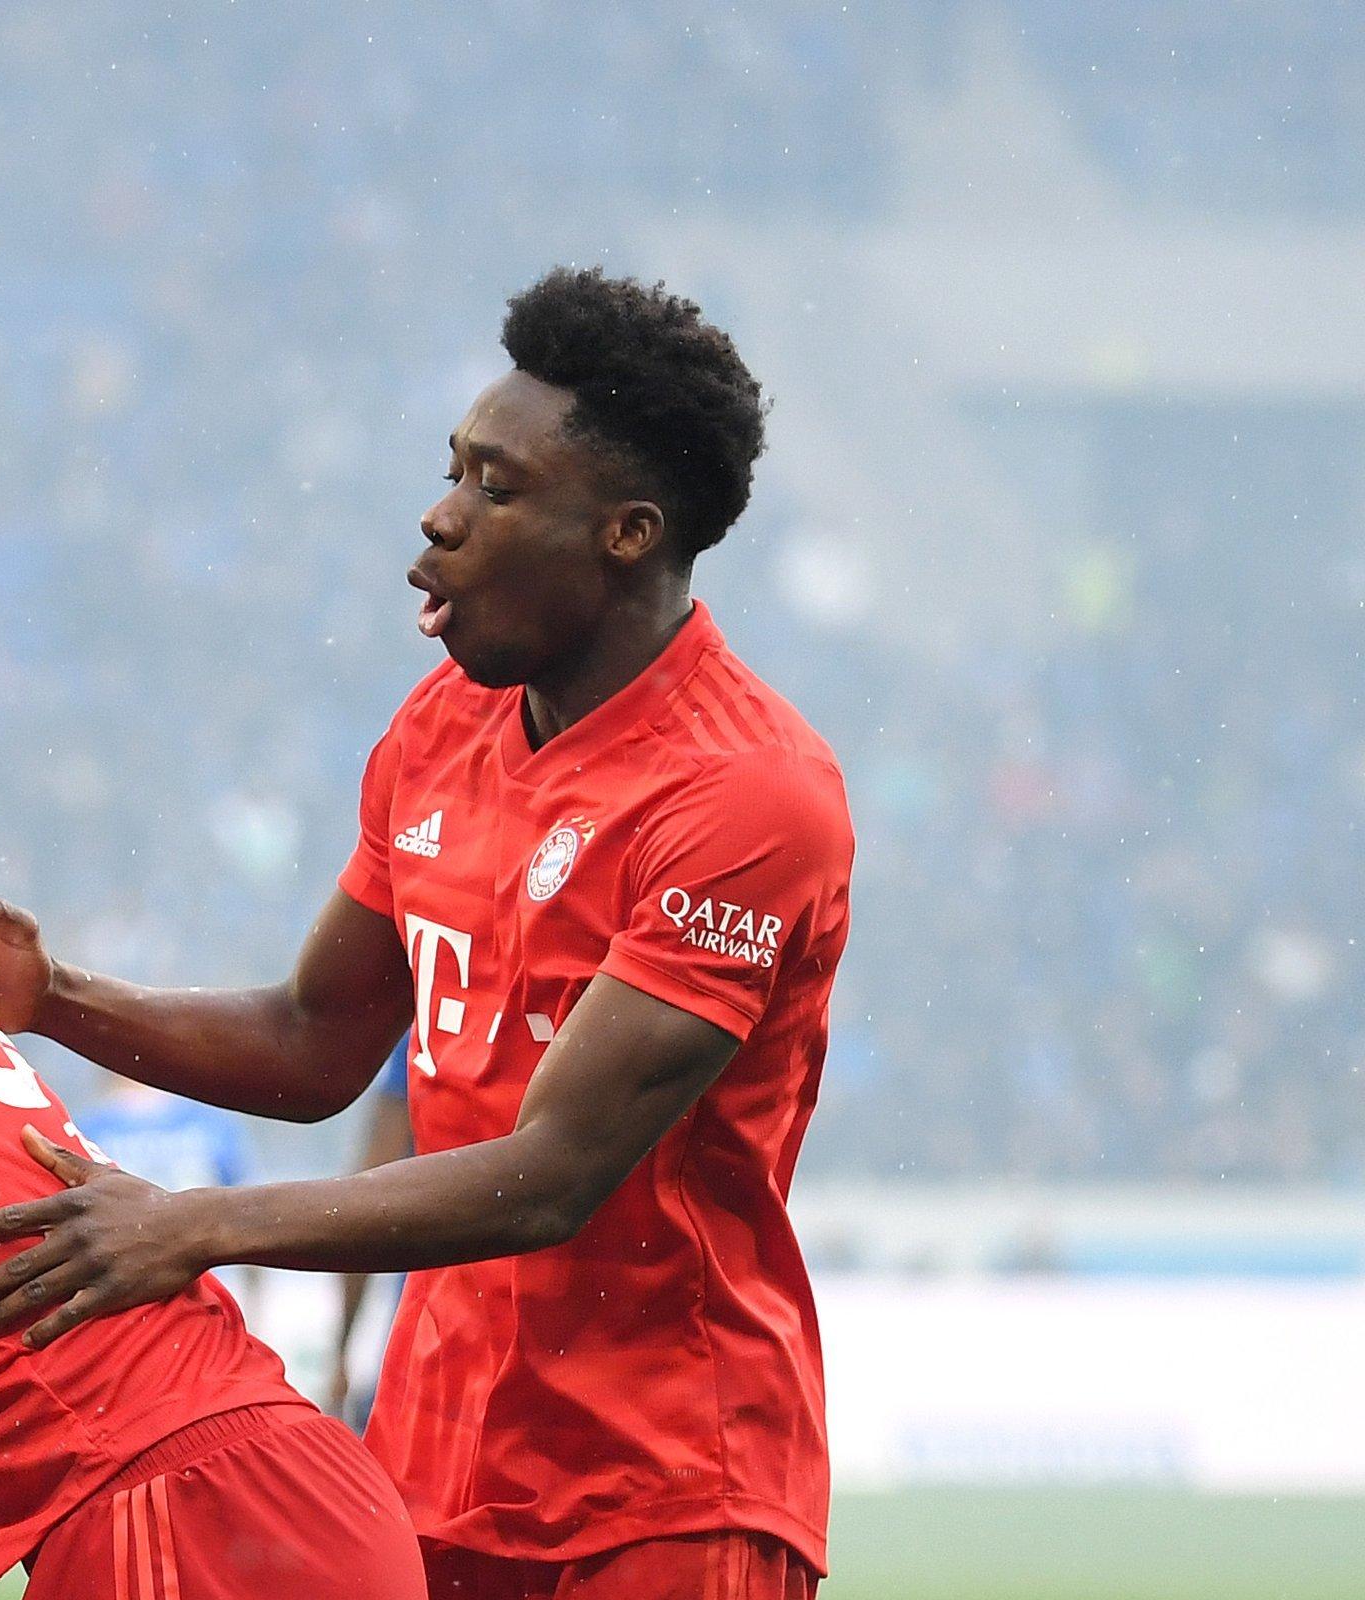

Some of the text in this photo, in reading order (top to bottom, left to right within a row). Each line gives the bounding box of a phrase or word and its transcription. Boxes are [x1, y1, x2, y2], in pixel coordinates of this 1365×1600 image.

[394, 833, 442, 859] adidas
[660, 886, 783, 949] QATAR
[681, 926, 776, 968] AIRWAYS
